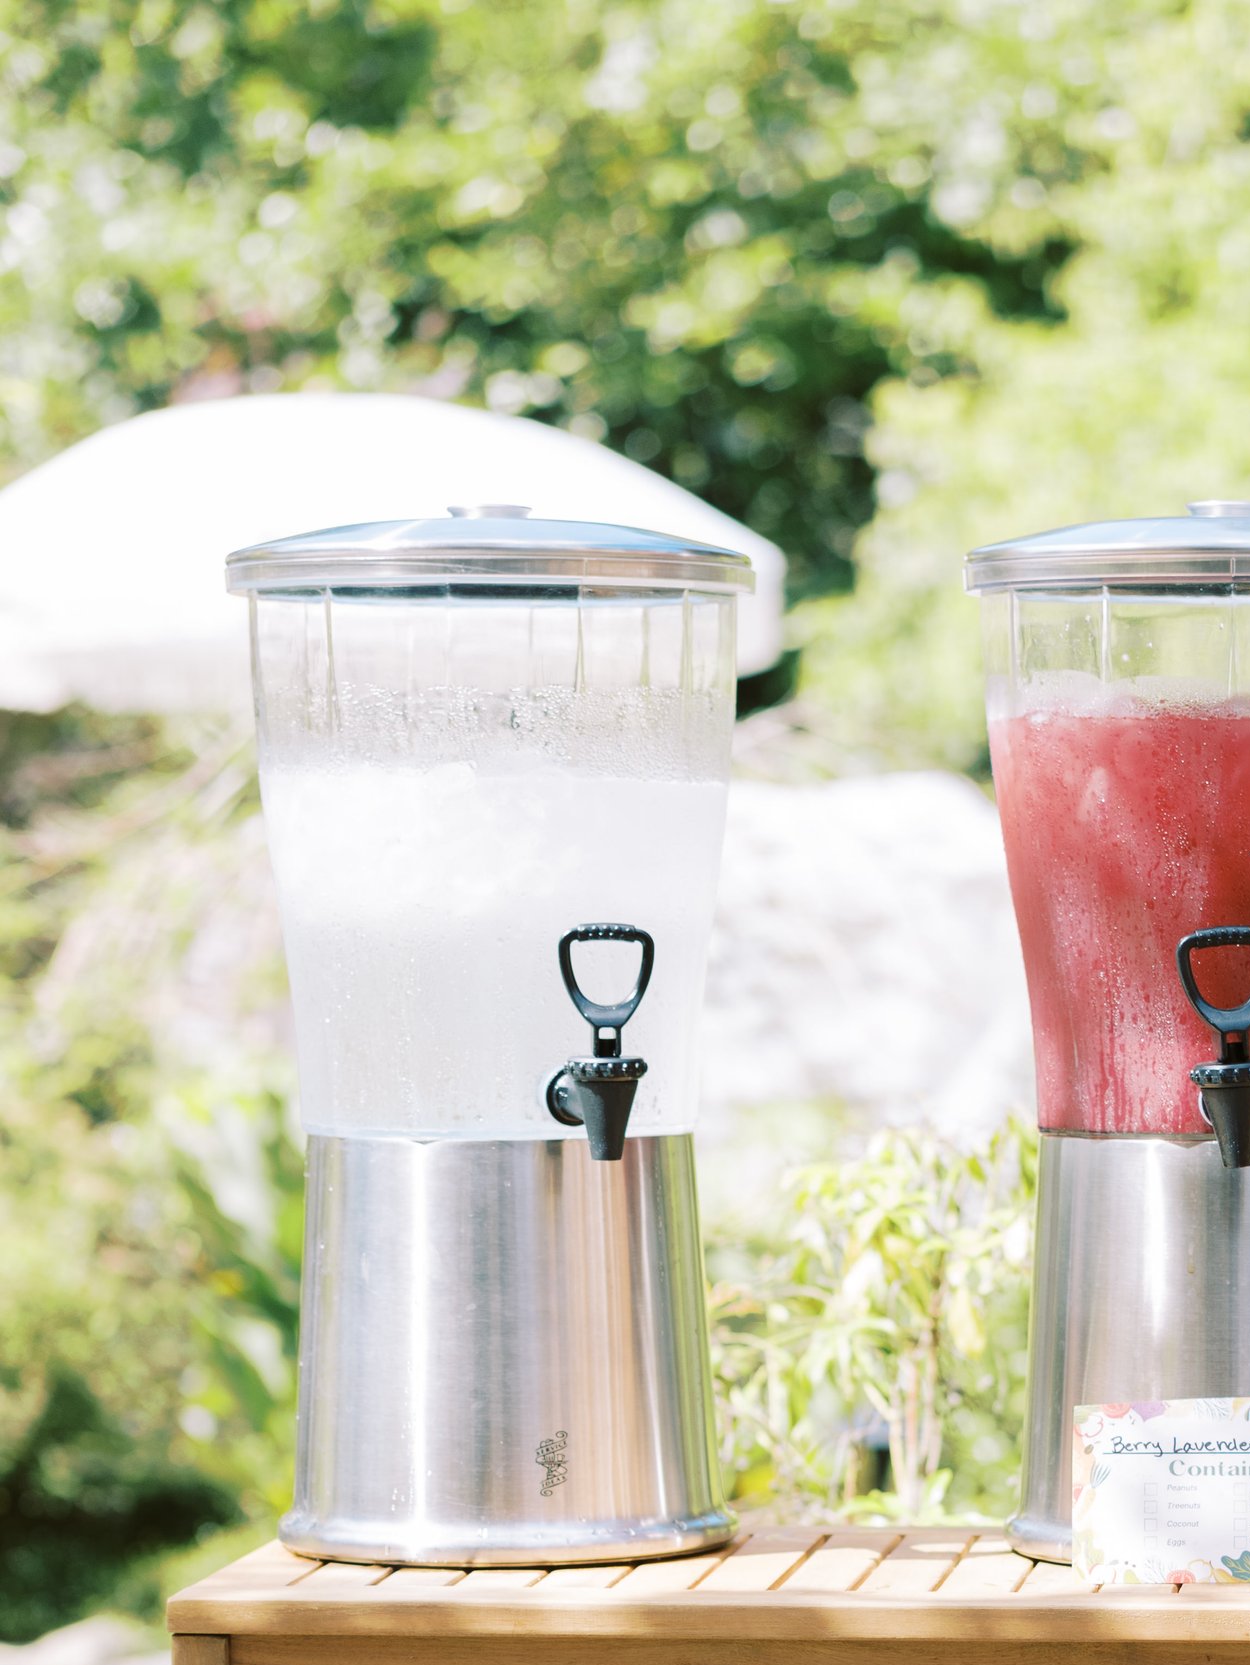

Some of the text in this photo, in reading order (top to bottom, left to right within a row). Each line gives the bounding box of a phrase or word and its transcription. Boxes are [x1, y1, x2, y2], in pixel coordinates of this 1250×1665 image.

[536, 1440, 566, 1455] SERVICE
[1111, 1435, 1164, 1457] Berry
[542, 1476, 566, 1487] IDEAS
[1166, 1483, 1198, 1492] Peanuts
[1167, 1501, 1201, 1510] Treenuts
[1166, 1519, 1199, 1528] Coconut
[1166, 1537, 1186, 1547] Eggs
